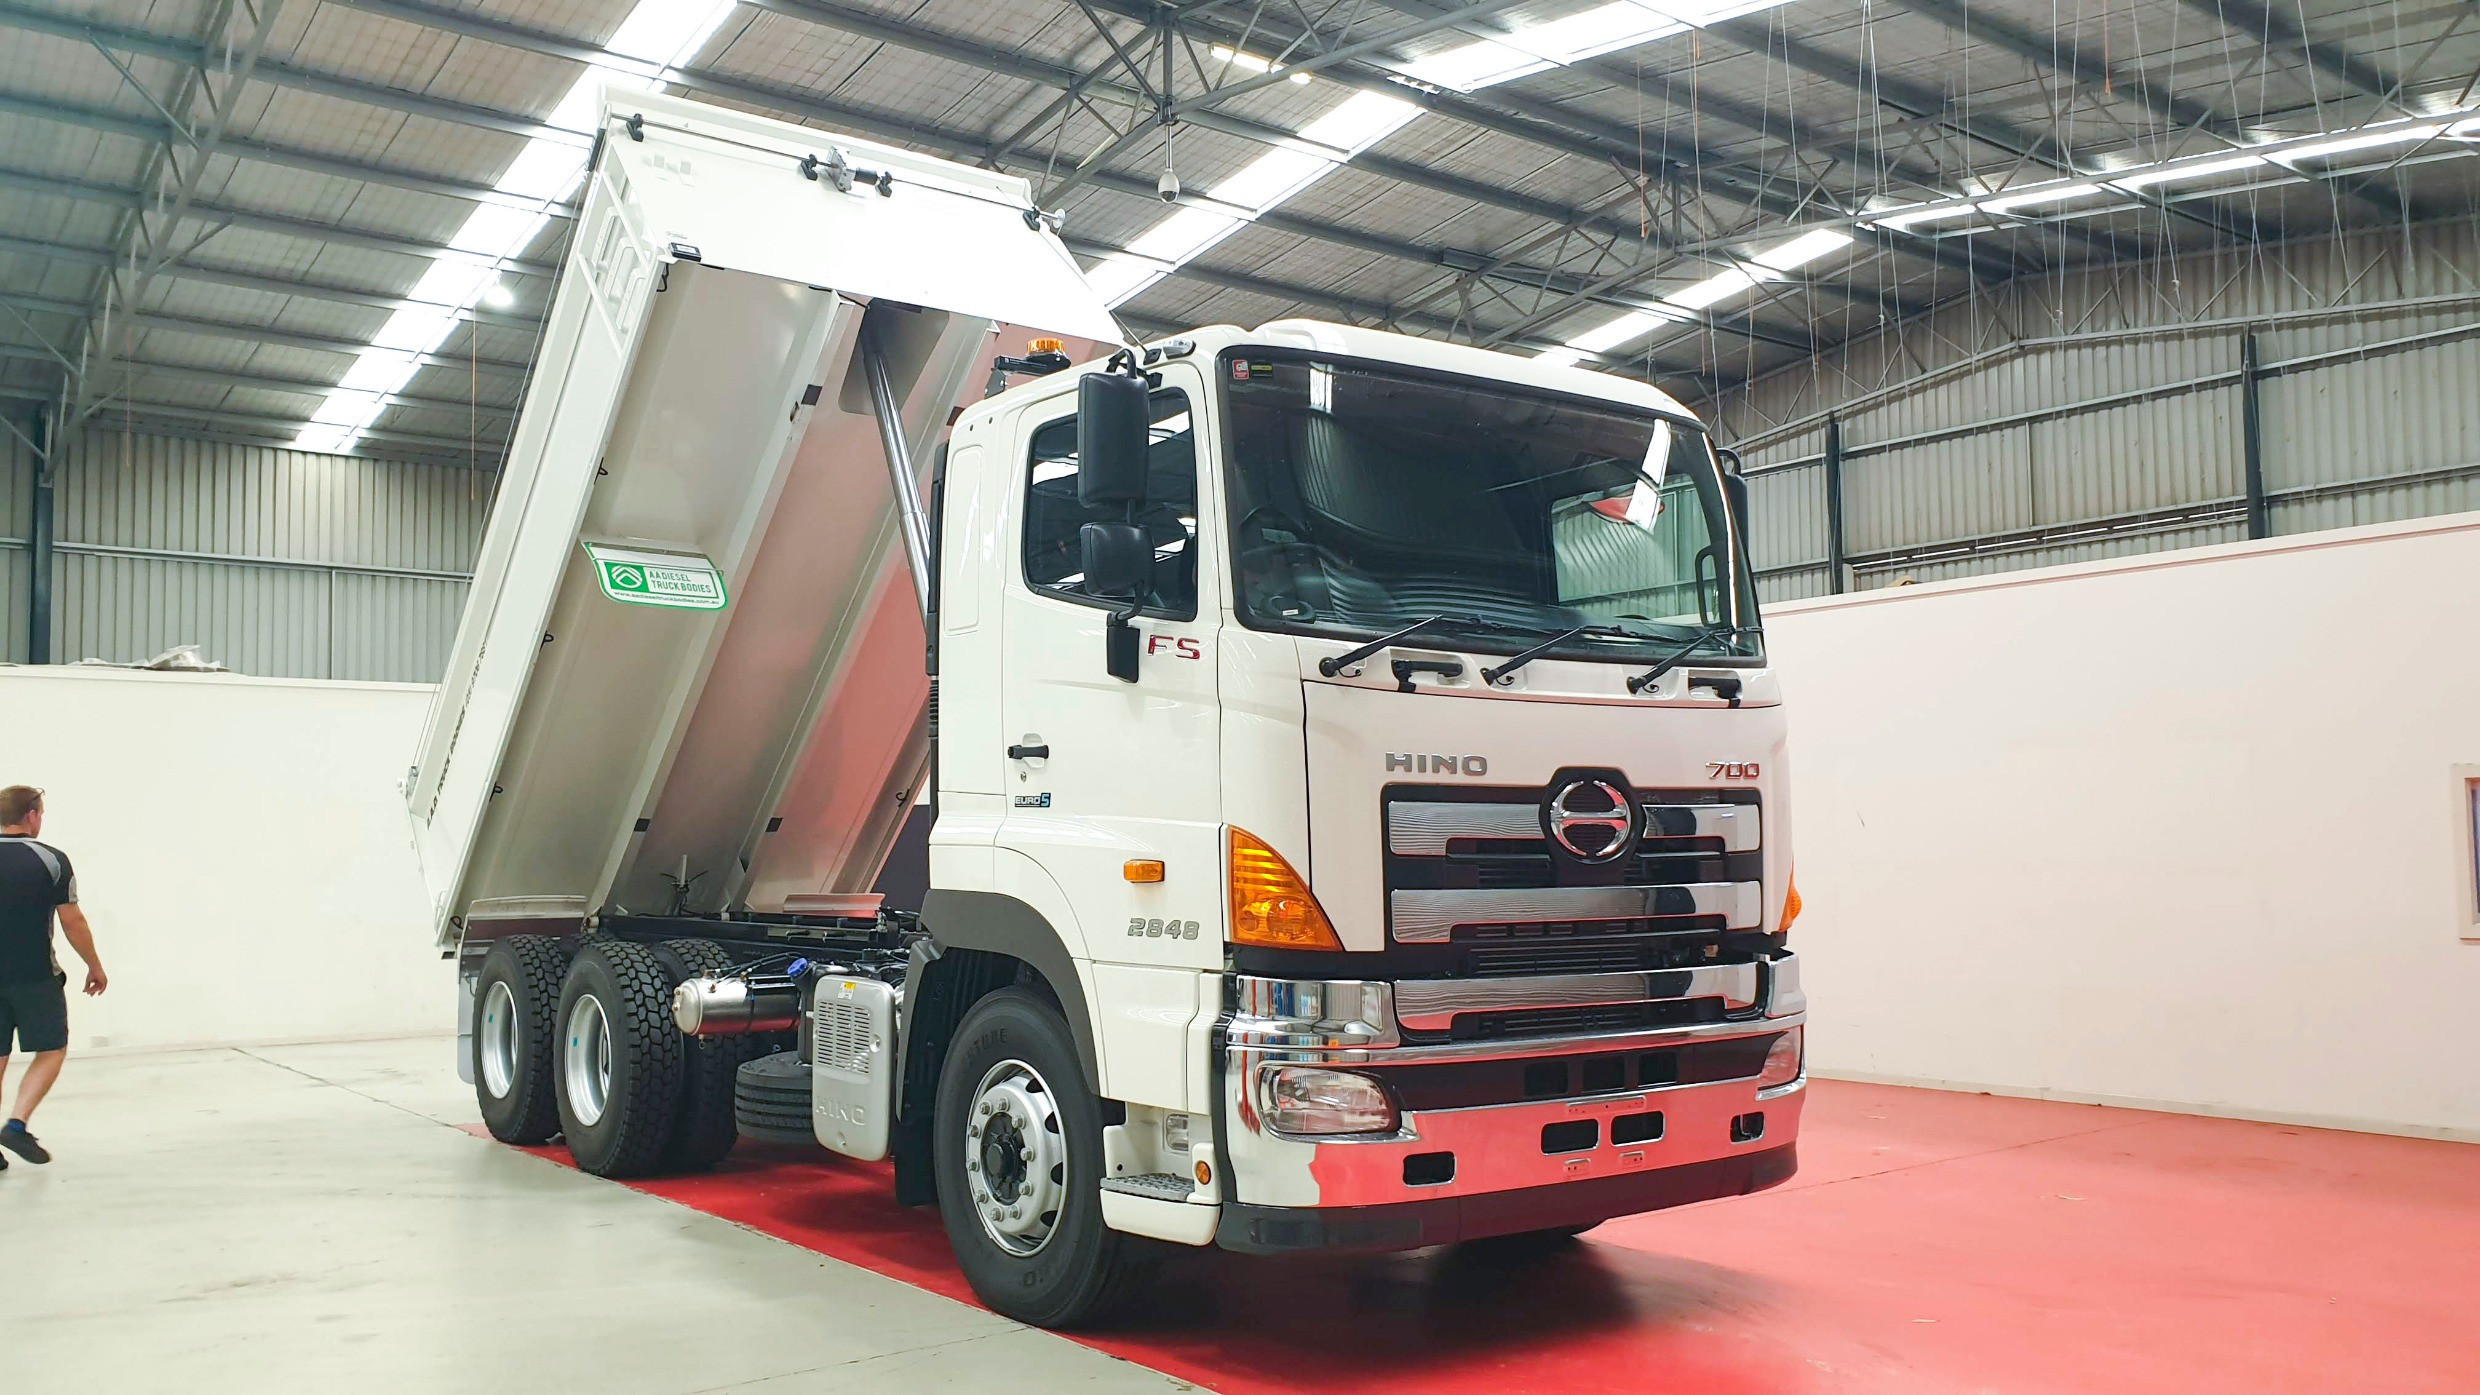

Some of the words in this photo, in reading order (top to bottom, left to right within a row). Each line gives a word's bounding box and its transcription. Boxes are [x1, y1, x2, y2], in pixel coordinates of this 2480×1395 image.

[651, 580, 680, 591] TRUCK
[681, 583, 712, 593] BODIES
[1148, 634, 1200, 660] FS
[1385, 751, 1487, 777] HINO
[1705, 760, 1760, 780] 700
[1127, 917, 1200, 940] 2848
